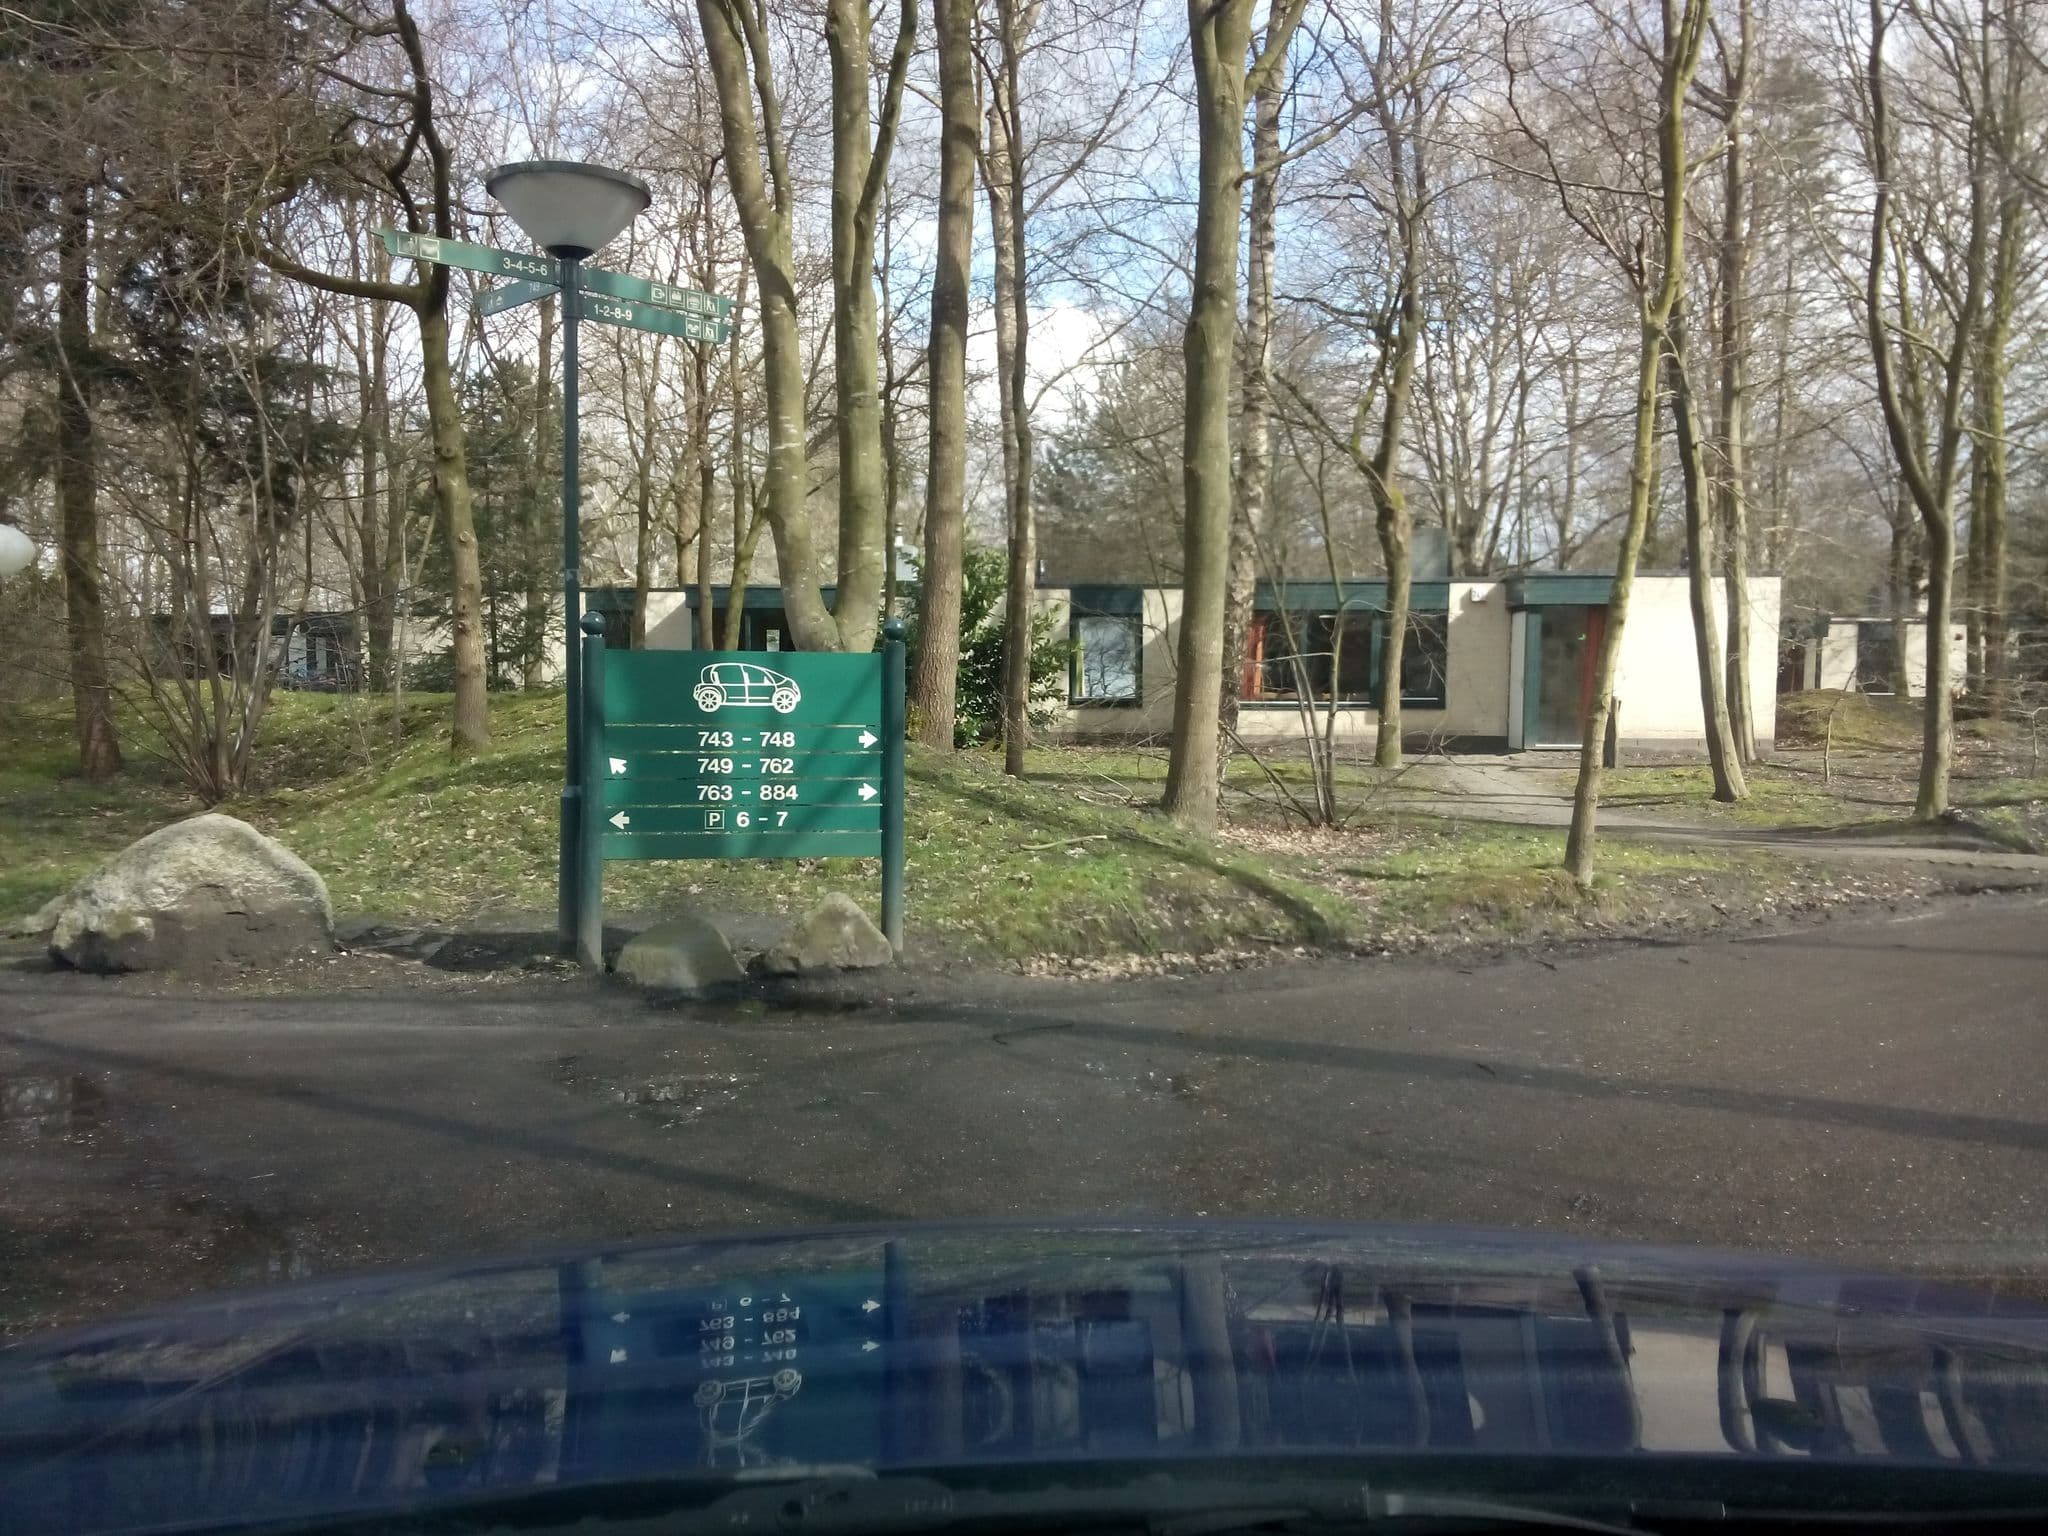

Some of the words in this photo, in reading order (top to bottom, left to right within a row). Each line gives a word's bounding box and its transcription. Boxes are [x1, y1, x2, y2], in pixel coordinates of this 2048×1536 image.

[503, 257, 548, 276] 3-4-5-6
[594, 303, 633, 321] 1-2-8-9
[698, 731, 734, 748] 743
[759, 731, 796, 748] 748
[697, 757, 734, 774] 749
[759, 757, 795, 774] 762
[697, 784, 733, 801] 763
[759, 784, 799, 801] 884
[736, 811, 750, 828] 6
[776, 811, 789, 827] 7
